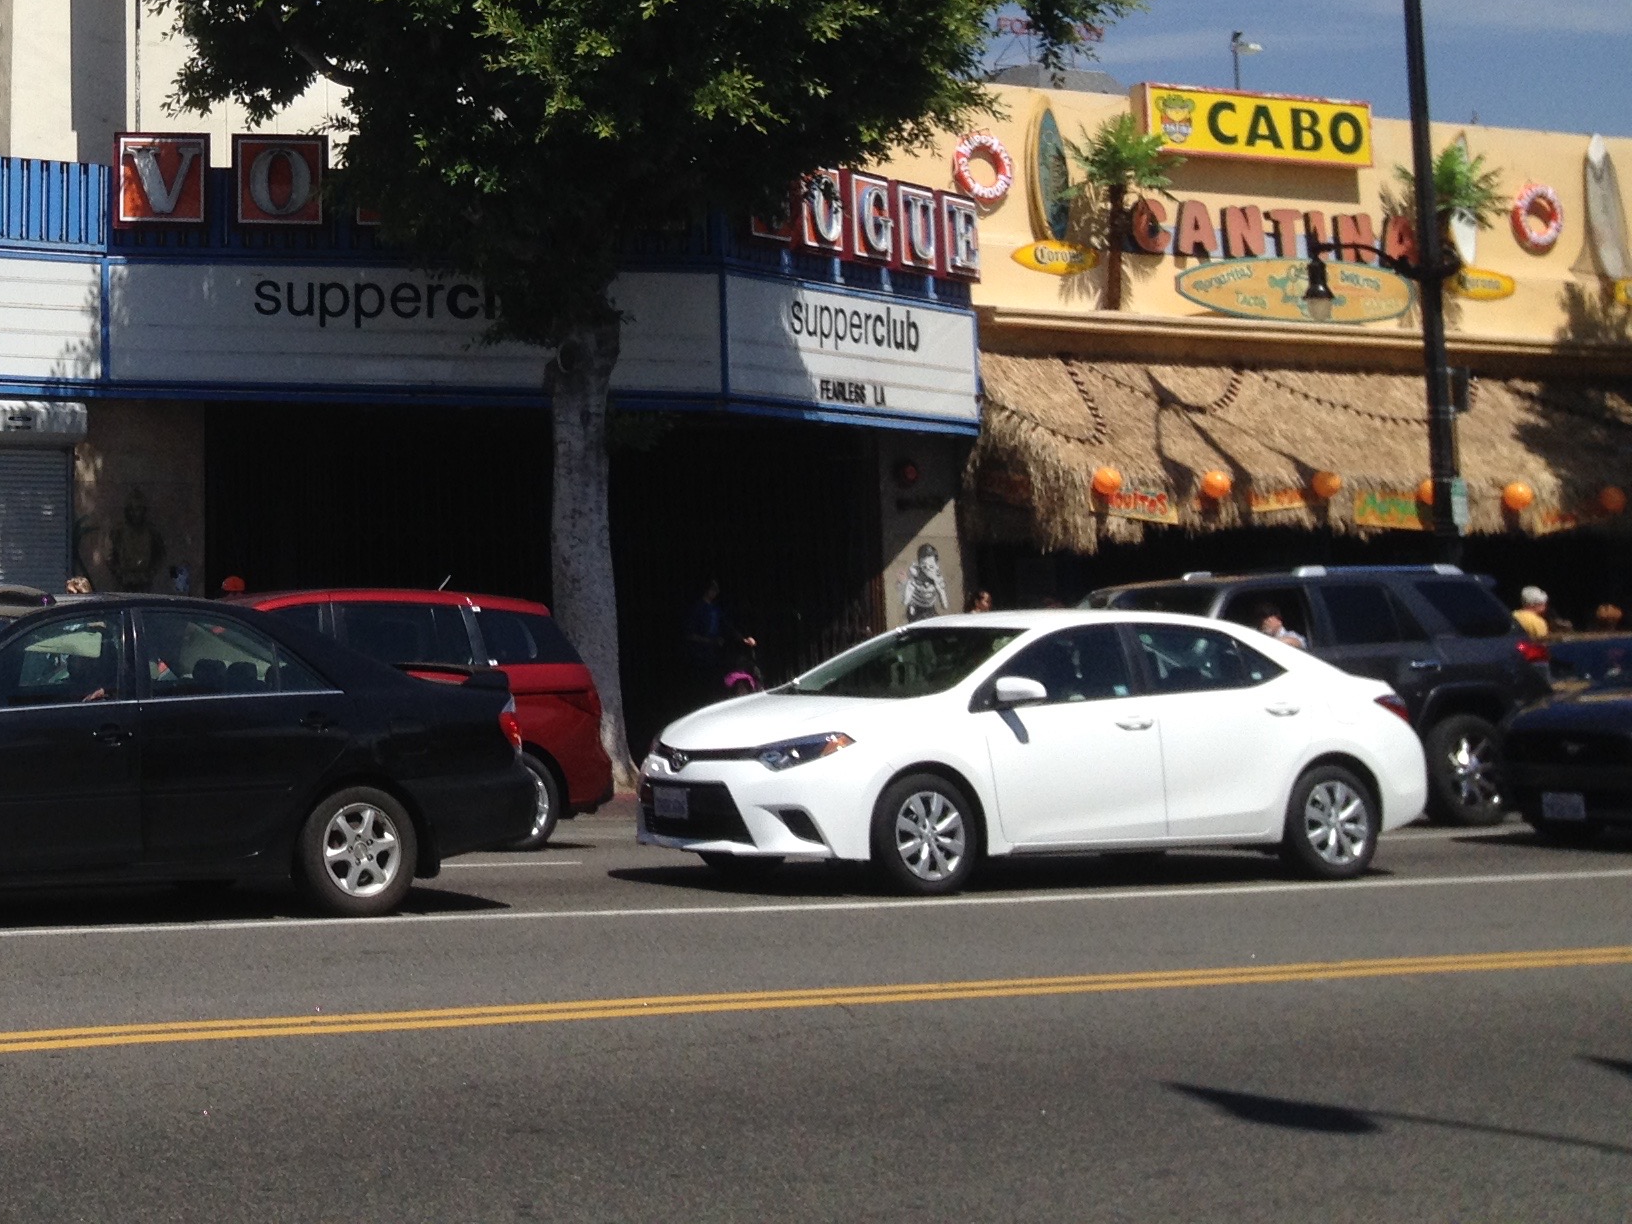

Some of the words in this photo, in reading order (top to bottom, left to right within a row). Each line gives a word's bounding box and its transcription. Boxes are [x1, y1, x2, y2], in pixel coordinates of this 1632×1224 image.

[1207, 100, 1363, 155] CABO
[808, 174, 981, 270] OGUE
[1130, 198, 1418, 266] CANTINA
[791, 300, 919, 352] supperclub
[820, 379, 867, 404] FEARLESS
[873, 385, 886, 406] LA
